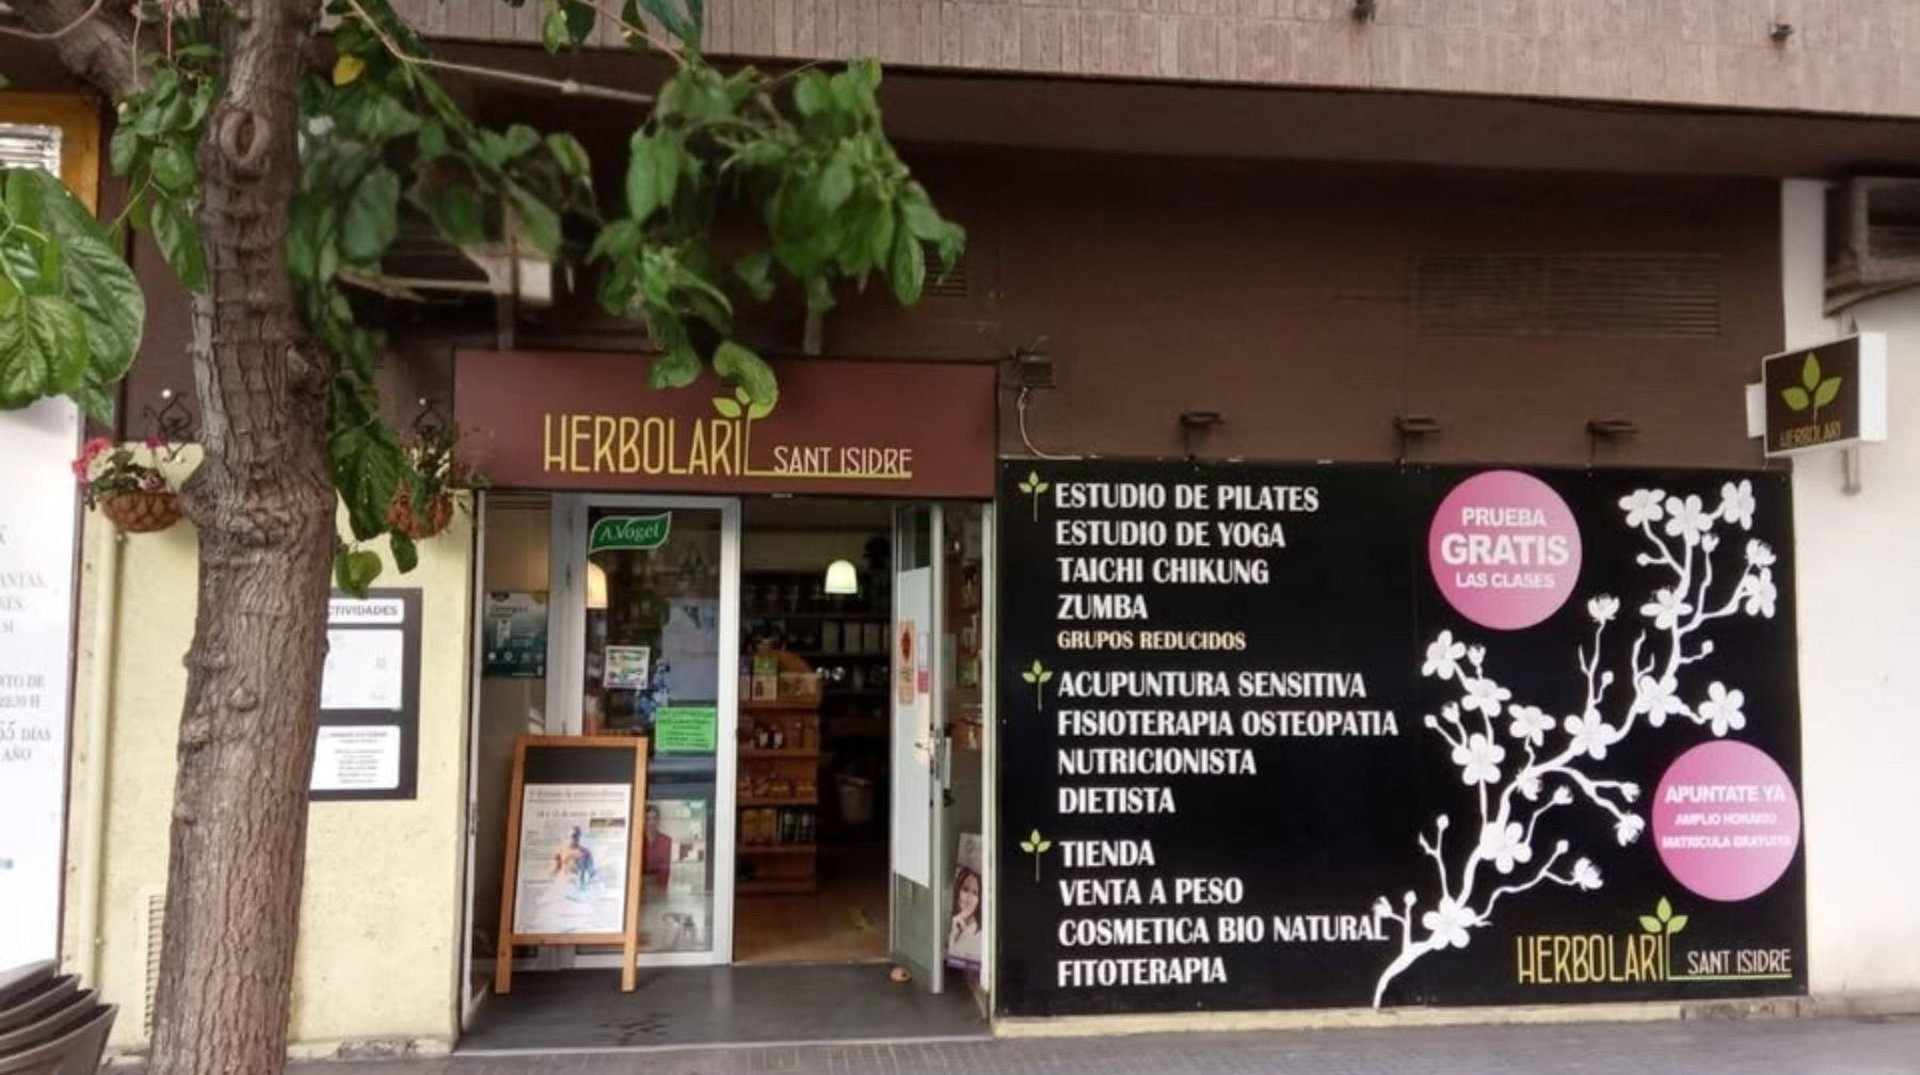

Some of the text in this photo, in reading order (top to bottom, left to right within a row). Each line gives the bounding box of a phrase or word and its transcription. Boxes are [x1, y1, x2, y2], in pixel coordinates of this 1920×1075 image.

[544, 413, 913, 476] HERBOLARI SANT ISIDRE
[1055, 483, 1319, 512] ESTUDIO DE PILATES
[1462, 507, 1546, 526] PRUEBA
[1055, 520, 1285, 548] ESTUDIO DE YOGA
[1441, 533, 1570, 566] GRATIS
[1056, 557, 1269, 584] TAICHI CHIKUNG
[1455, 572, 1555, 589] LAS CLASES
[1056, 594, 1148, 620] ZUMBA
[1057, 631, 1246, 651] GRUPOS REDUCIDOS
[1058, 671, 1366, 698] ACUPUNTURA SENSITIVA
[1058, 710, 1399, 737] FISIOTERAPIA OSTEOPATIA
[1058, 748, 1256, 775] NUTRICIONISTA
[1058, 787, 1176, 814] DIETISTA
[1665, 784, 1786, 803] APUNTATE YA
[1059, 840, 1155, 867] TIENDA
[1059, 878, 1243, 906] VENTA A PESO
[1058, 914, 1390, 946] COSMETICA BIO NATURAL
[1058, 957, 1227, 987] FITOTERAPIA
[1517, 933, 1791, 984] HERBOLARI SANT ISIDRE
